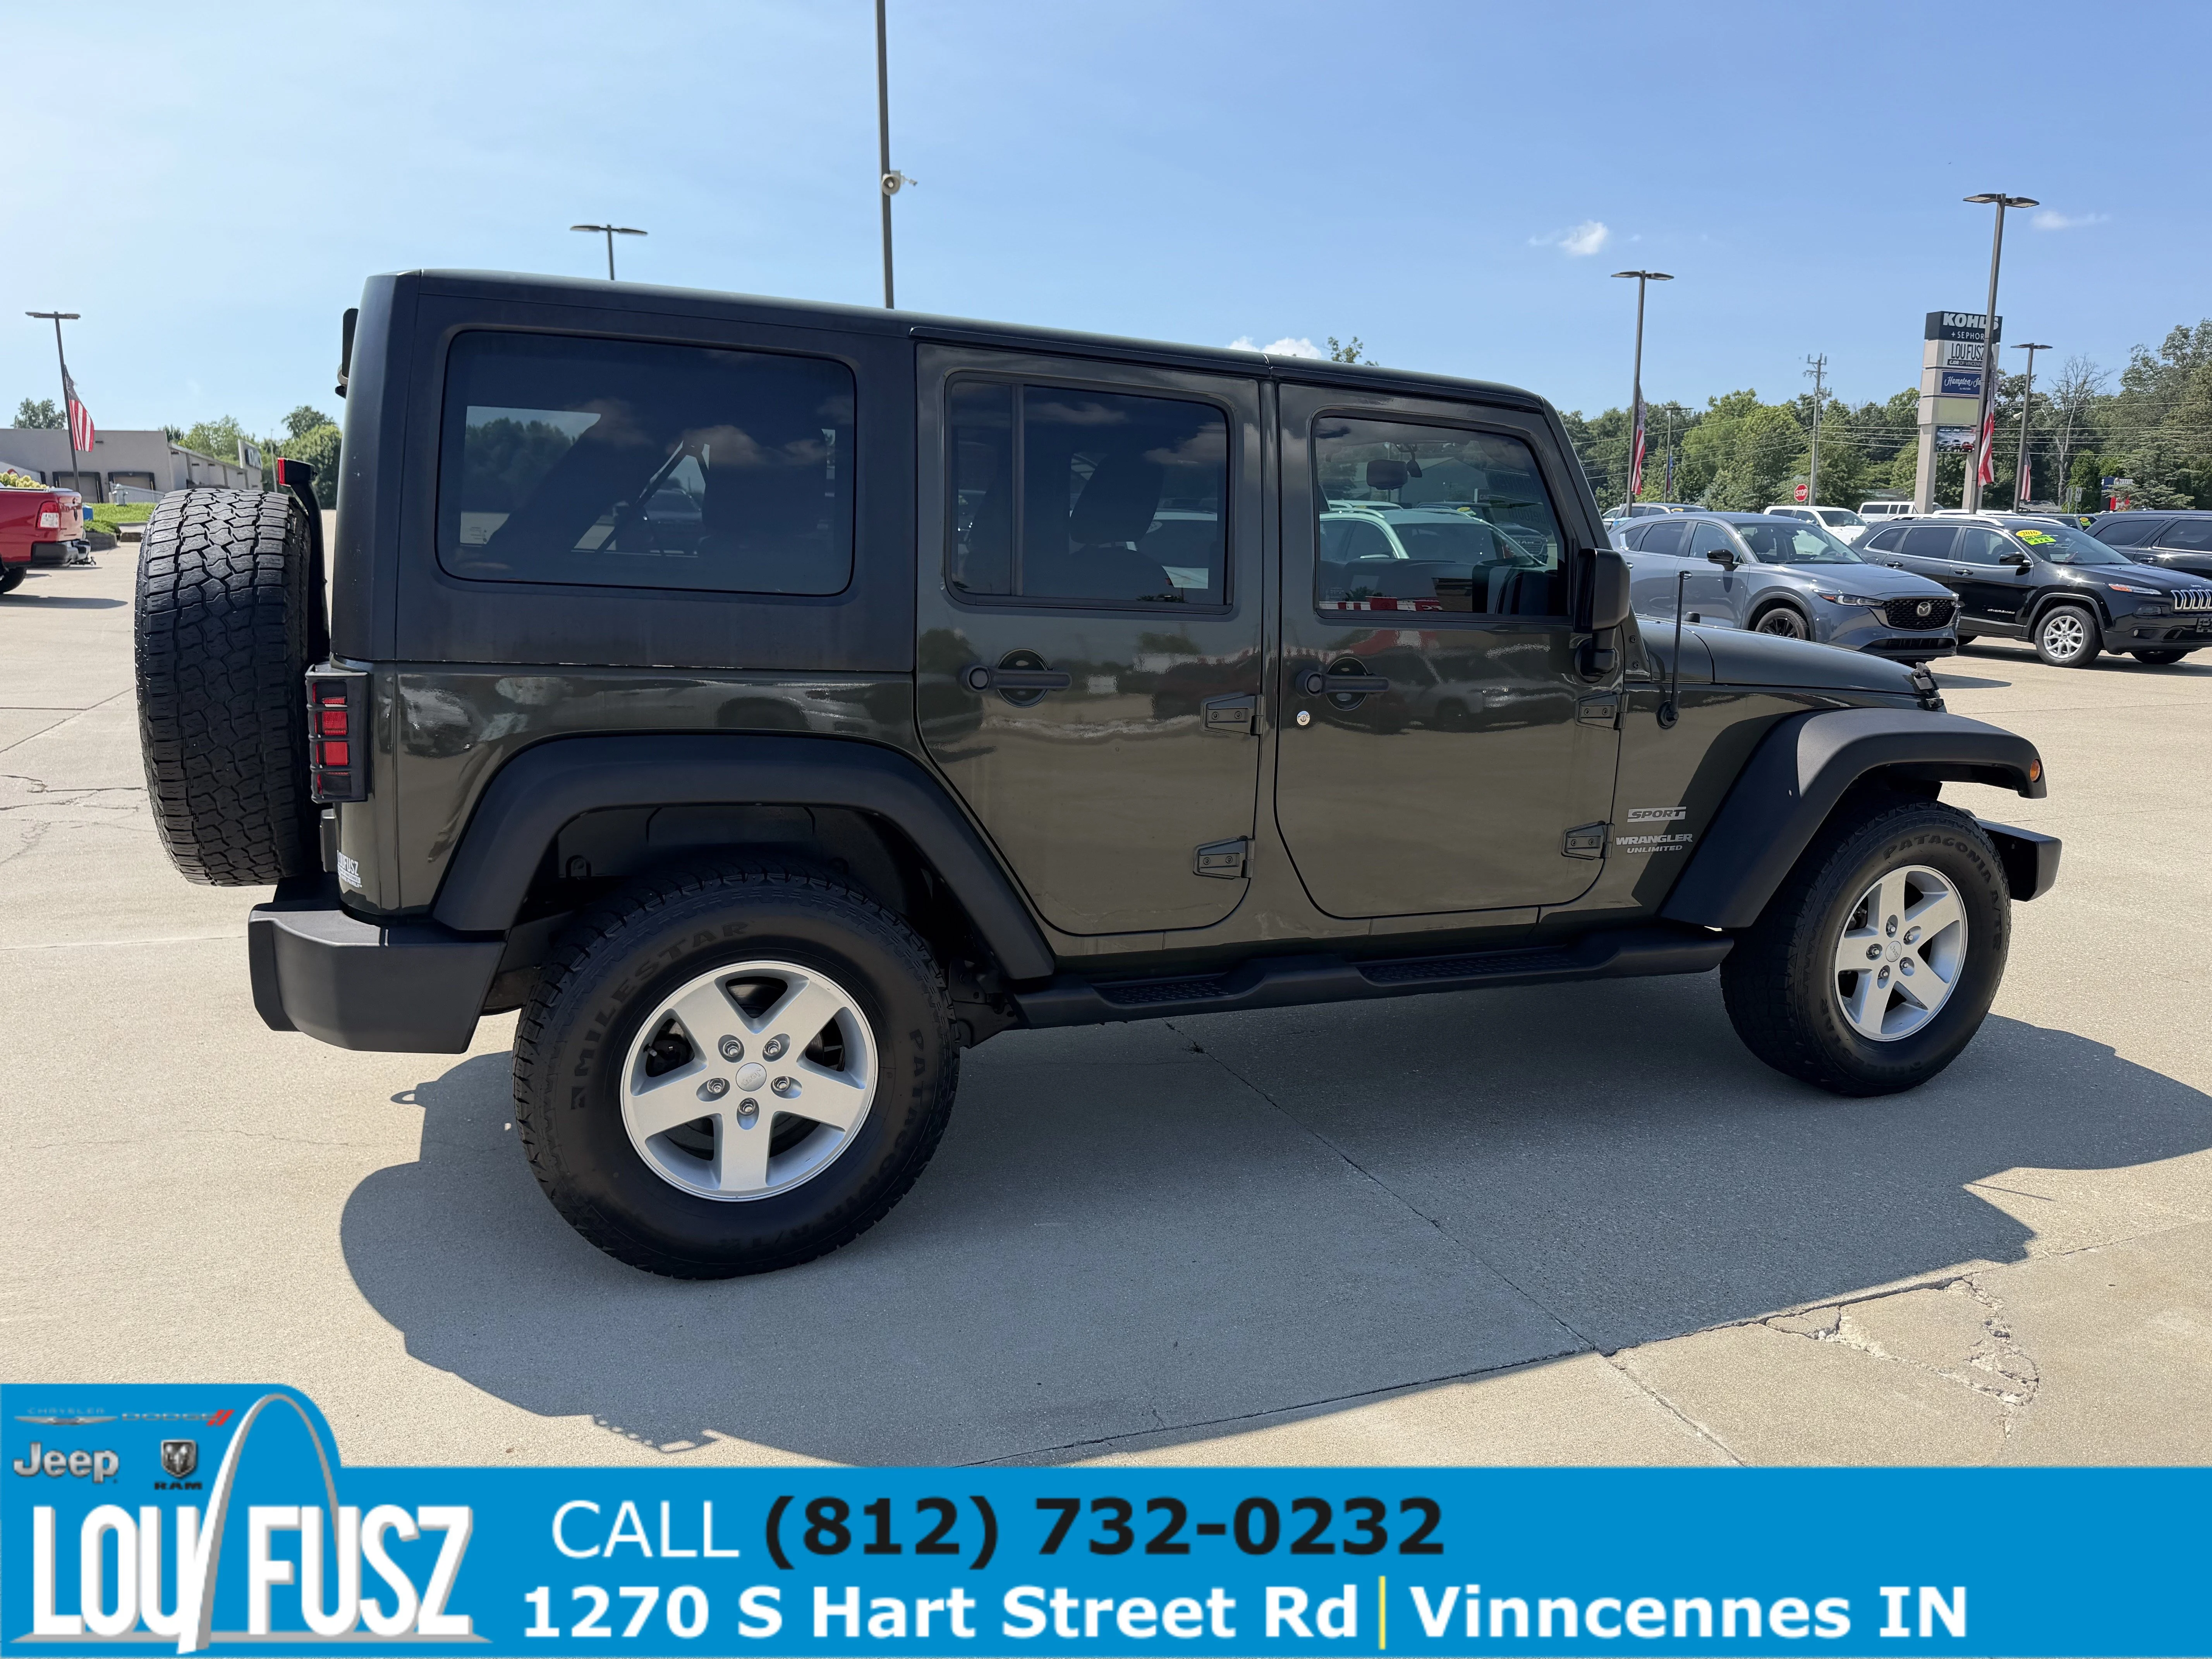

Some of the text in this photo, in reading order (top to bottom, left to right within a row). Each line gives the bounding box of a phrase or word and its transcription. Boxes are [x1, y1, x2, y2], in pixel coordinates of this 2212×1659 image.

[1943, 313, 1999, 330] KOHL
[1957, 331, 1985, 340] SEPHOR
[1951, 343, 1966, 359] LOU
[1944, 376, 1981, 387] Hampton In
[1795, 489, 1807, 497] STOP
[1632, 809, 1685, 819] SPORT
[1616, 833, 1693, 845] WRANGLER
[1626, 845, 1683, 854] UNLIMITED
[1883, 833, 1992, 883] PATAGONIA
[574, 921, 750, 1077] MILESTAR
